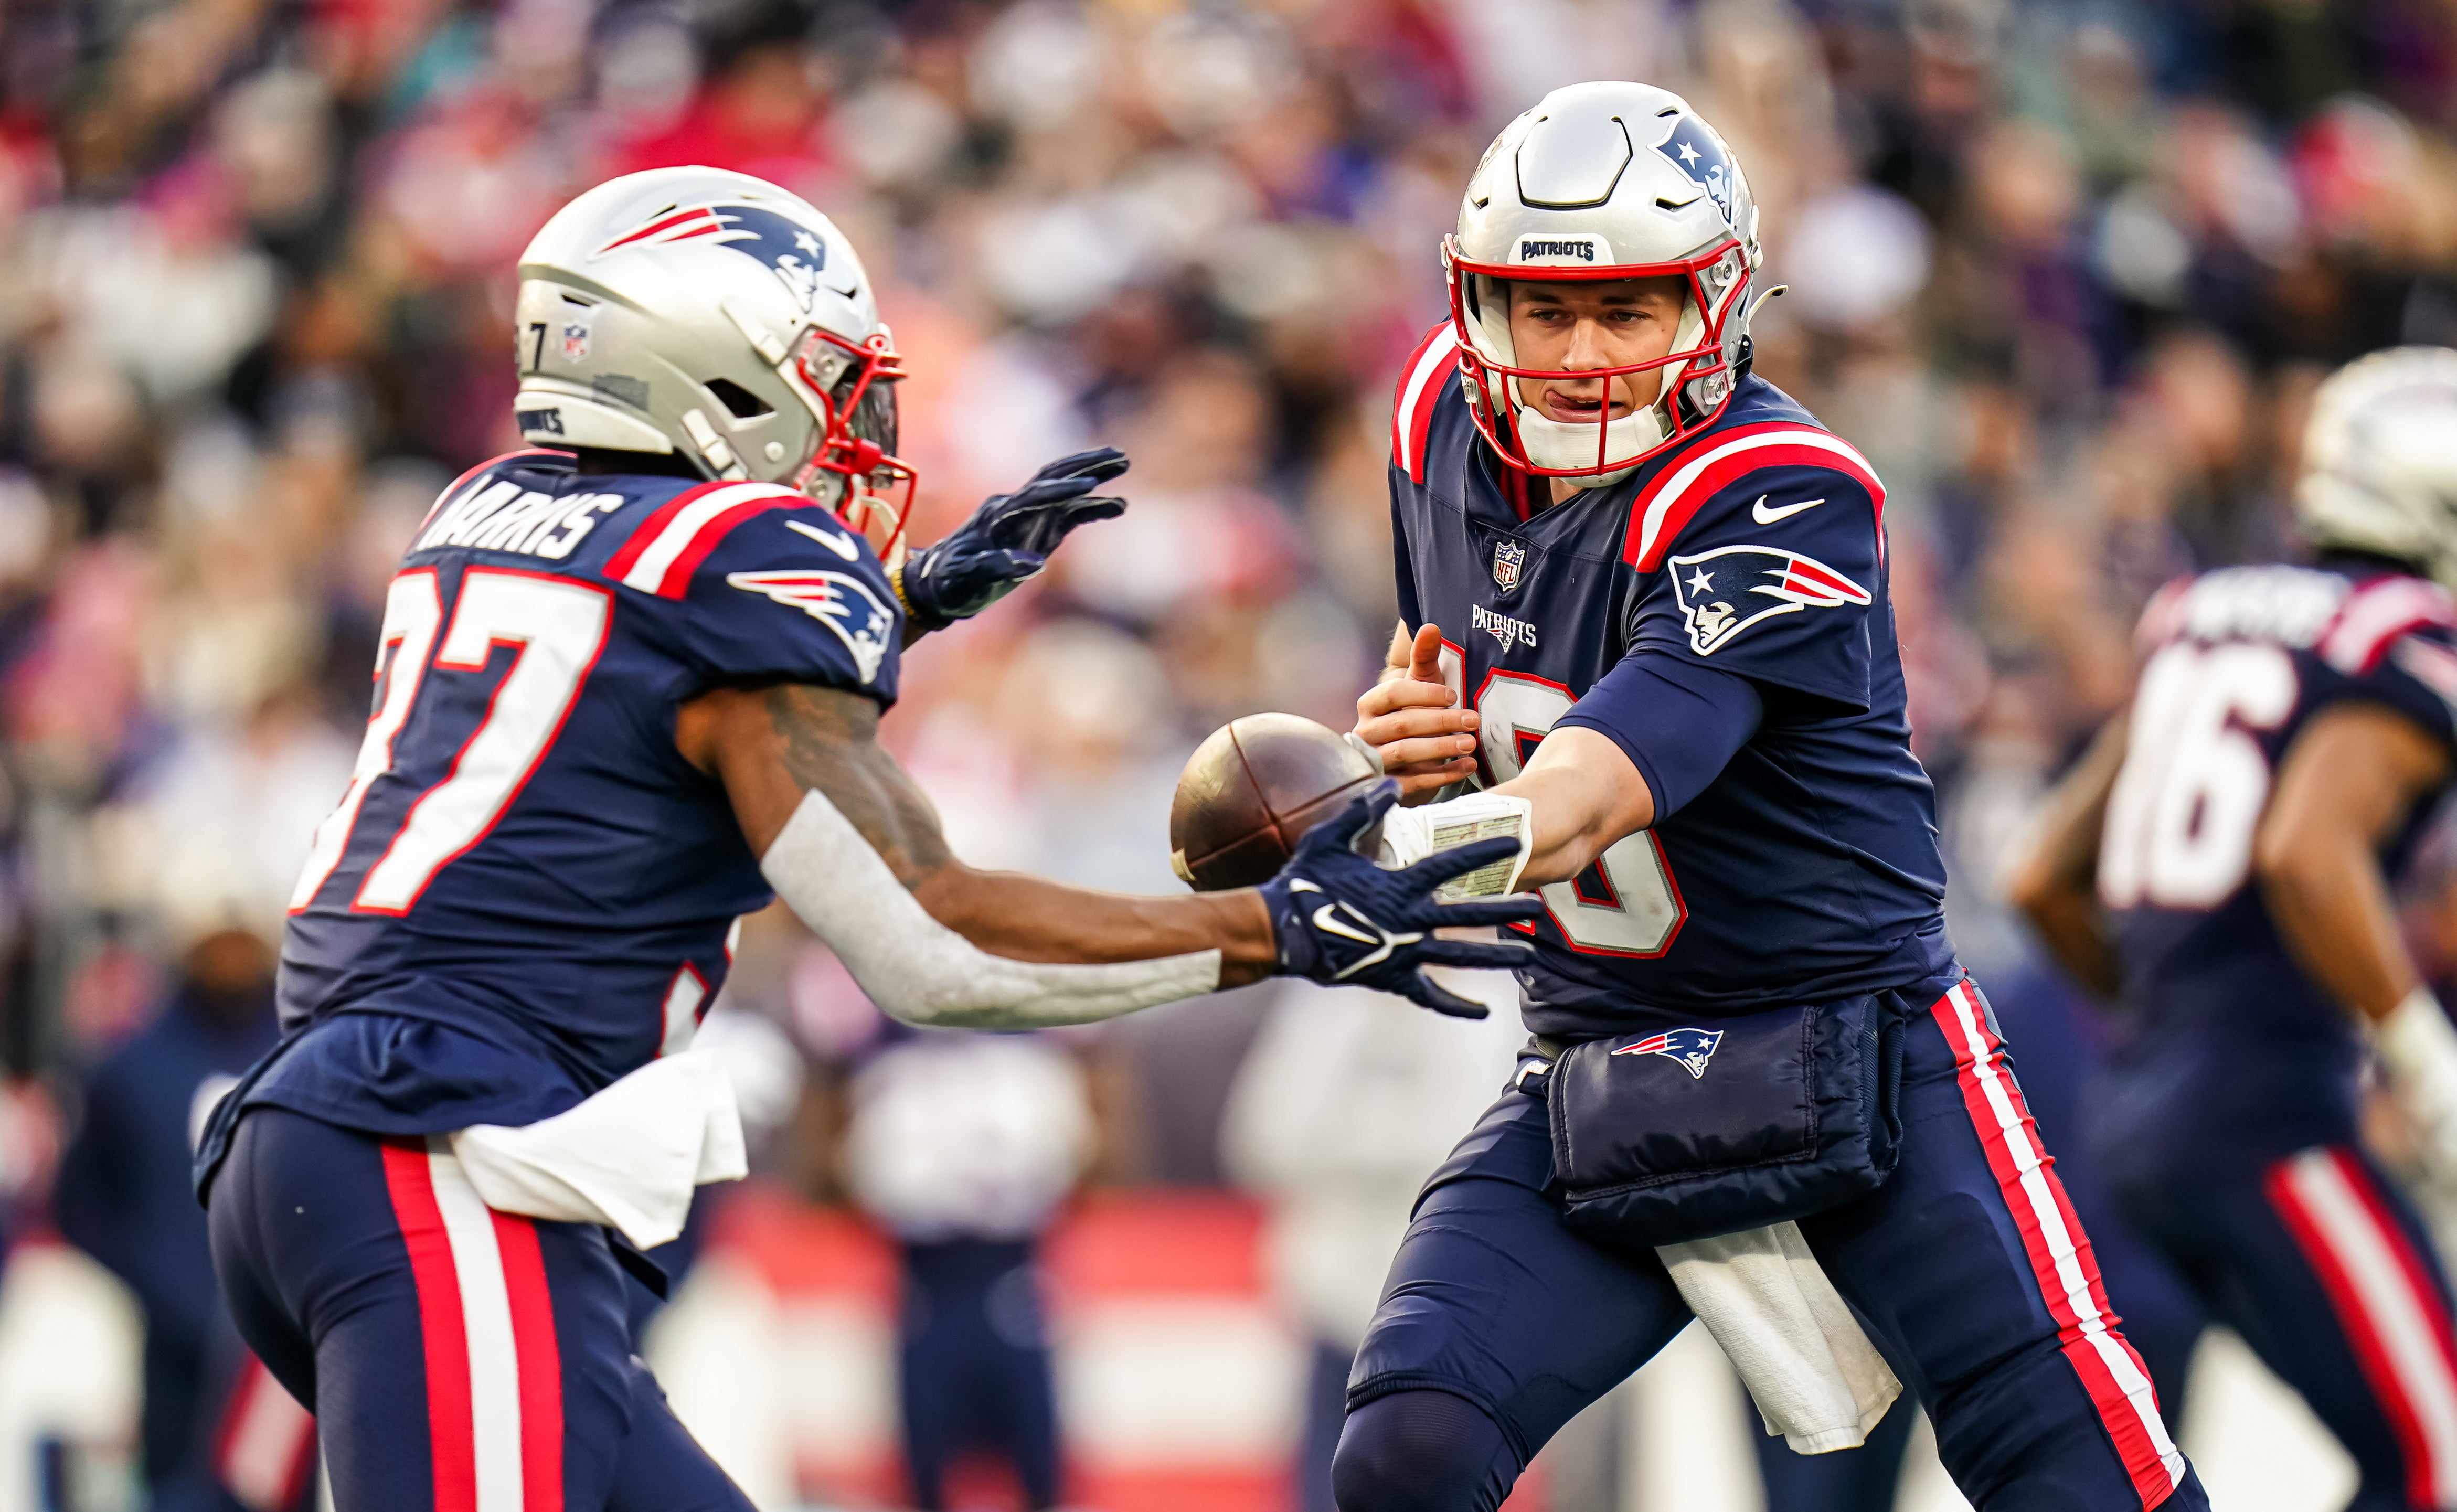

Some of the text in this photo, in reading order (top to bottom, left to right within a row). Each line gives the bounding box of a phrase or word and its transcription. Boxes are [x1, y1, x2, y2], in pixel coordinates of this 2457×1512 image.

[1522, 241, 1594, 261] PATRIOTS
[1497, 561, 1515, 582] NFL
[1472, 604, 1536, 647] PATRIOTS
[2098, 641, 2300, 912] 16
